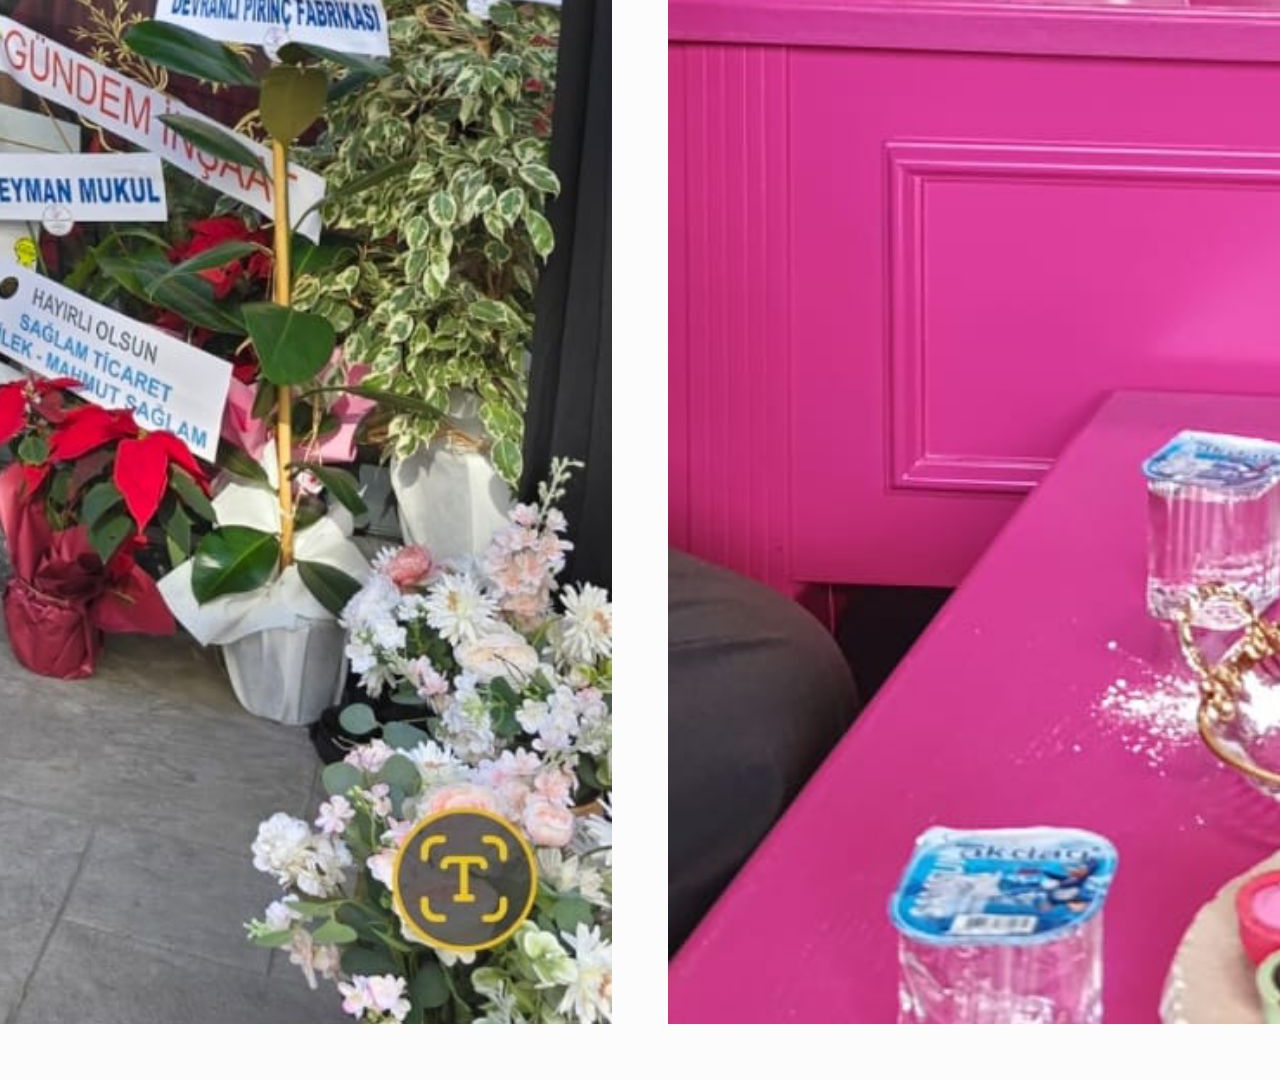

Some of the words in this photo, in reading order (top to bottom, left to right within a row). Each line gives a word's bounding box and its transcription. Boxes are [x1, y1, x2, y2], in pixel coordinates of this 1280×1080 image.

[3, 29, 152, 137] GÜNDEM
[80, 177, 161, 203] MUKUL
[19, 314, 89, 363] SAĞLAM
[94, 349, 173, 403] TİCARET
[32, 287, 93, 336] HAYIRLI
[95, 320, 158, 364] OLSUN
[45, 353, 120, 405] MAHMUT
[125, 393, 208, 450] SAĞLAM
